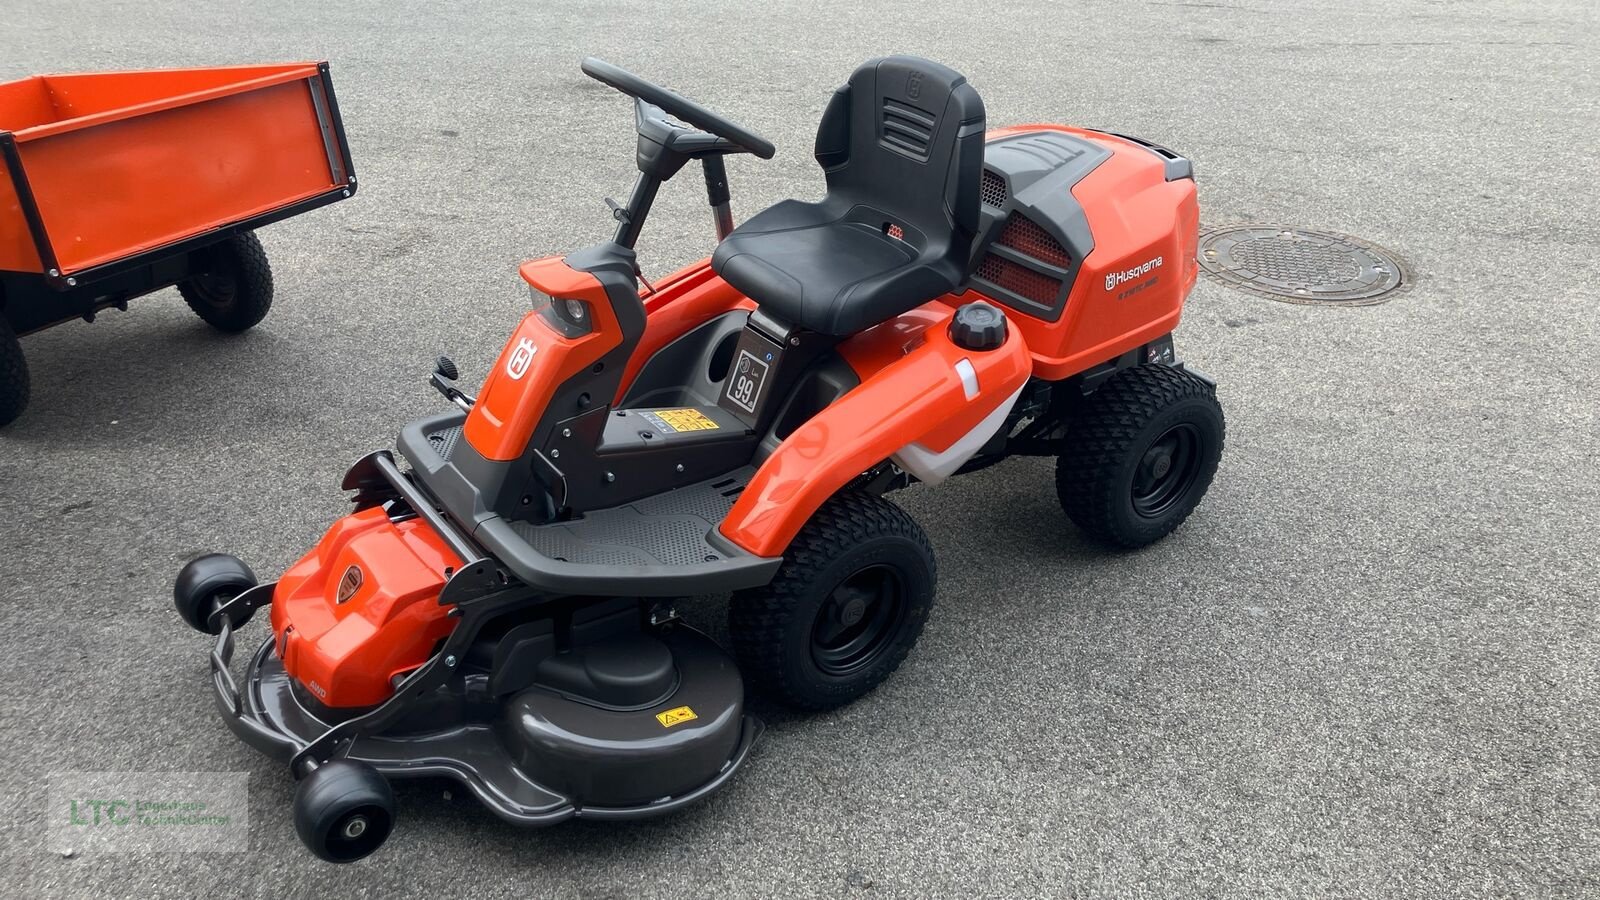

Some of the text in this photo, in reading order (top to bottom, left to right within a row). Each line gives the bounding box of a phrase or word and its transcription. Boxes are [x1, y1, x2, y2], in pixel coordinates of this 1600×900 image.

[1116, 256, 1163, 285] Husqvarna
[735, 375, 754, 404] 99
[310, 680, 327, 698] AWD
